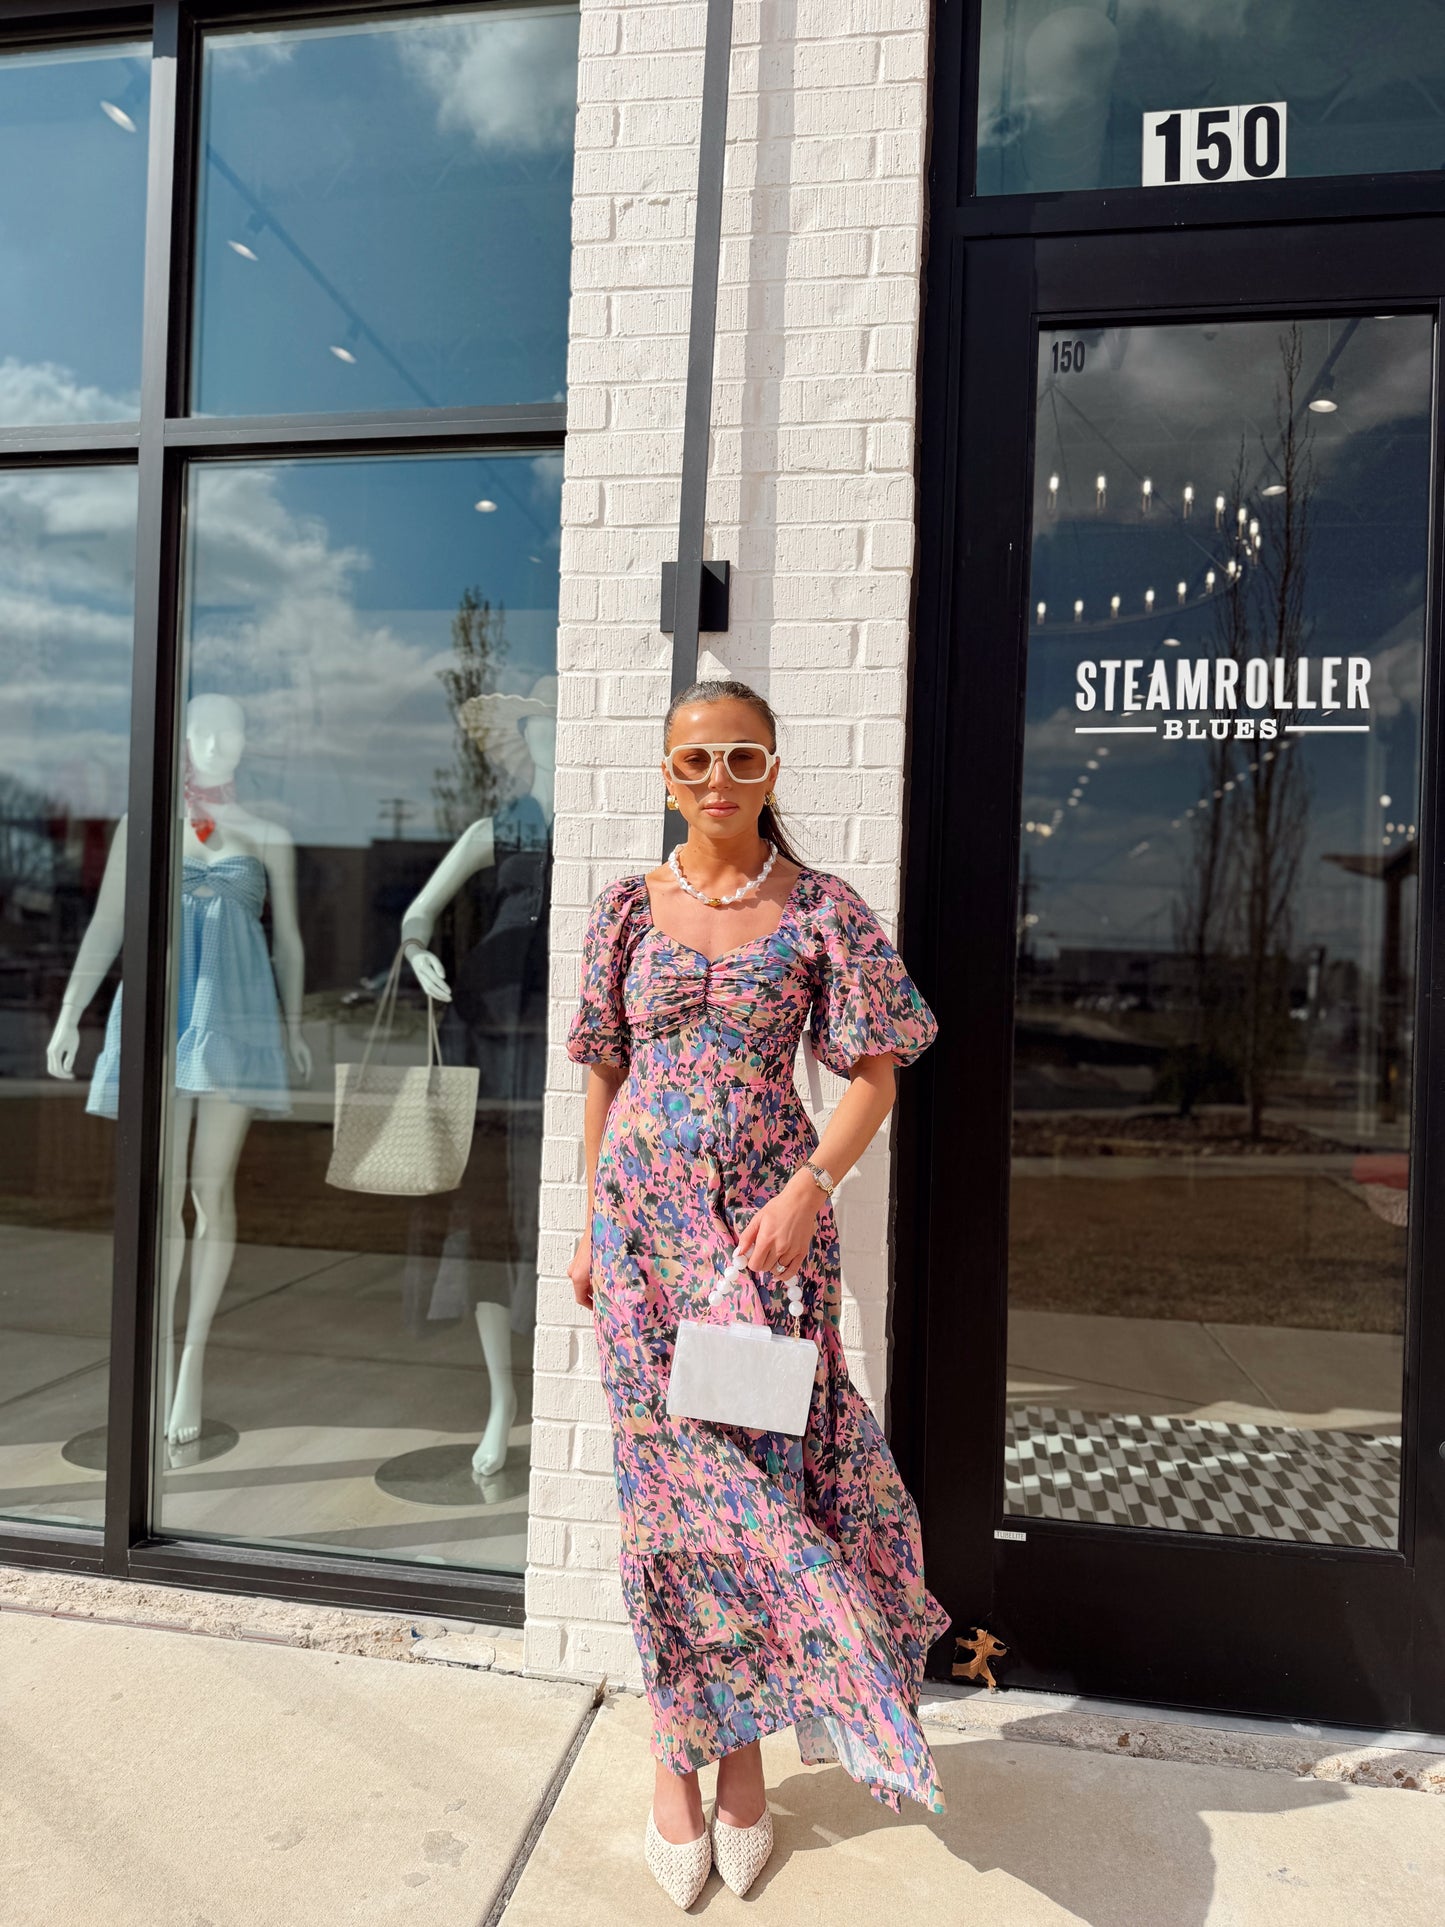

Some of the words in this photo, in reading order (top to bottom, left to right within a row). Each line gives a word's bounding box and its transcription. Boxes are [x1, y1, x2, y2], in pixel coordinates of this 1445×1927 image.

[1155, 105, 1280, 183] 150
[1051, 340, 1085, 374] 150
[1075, 657, 1371, 711] STEAMROLLER
[1163, 718, 1278, 740] BLUES
